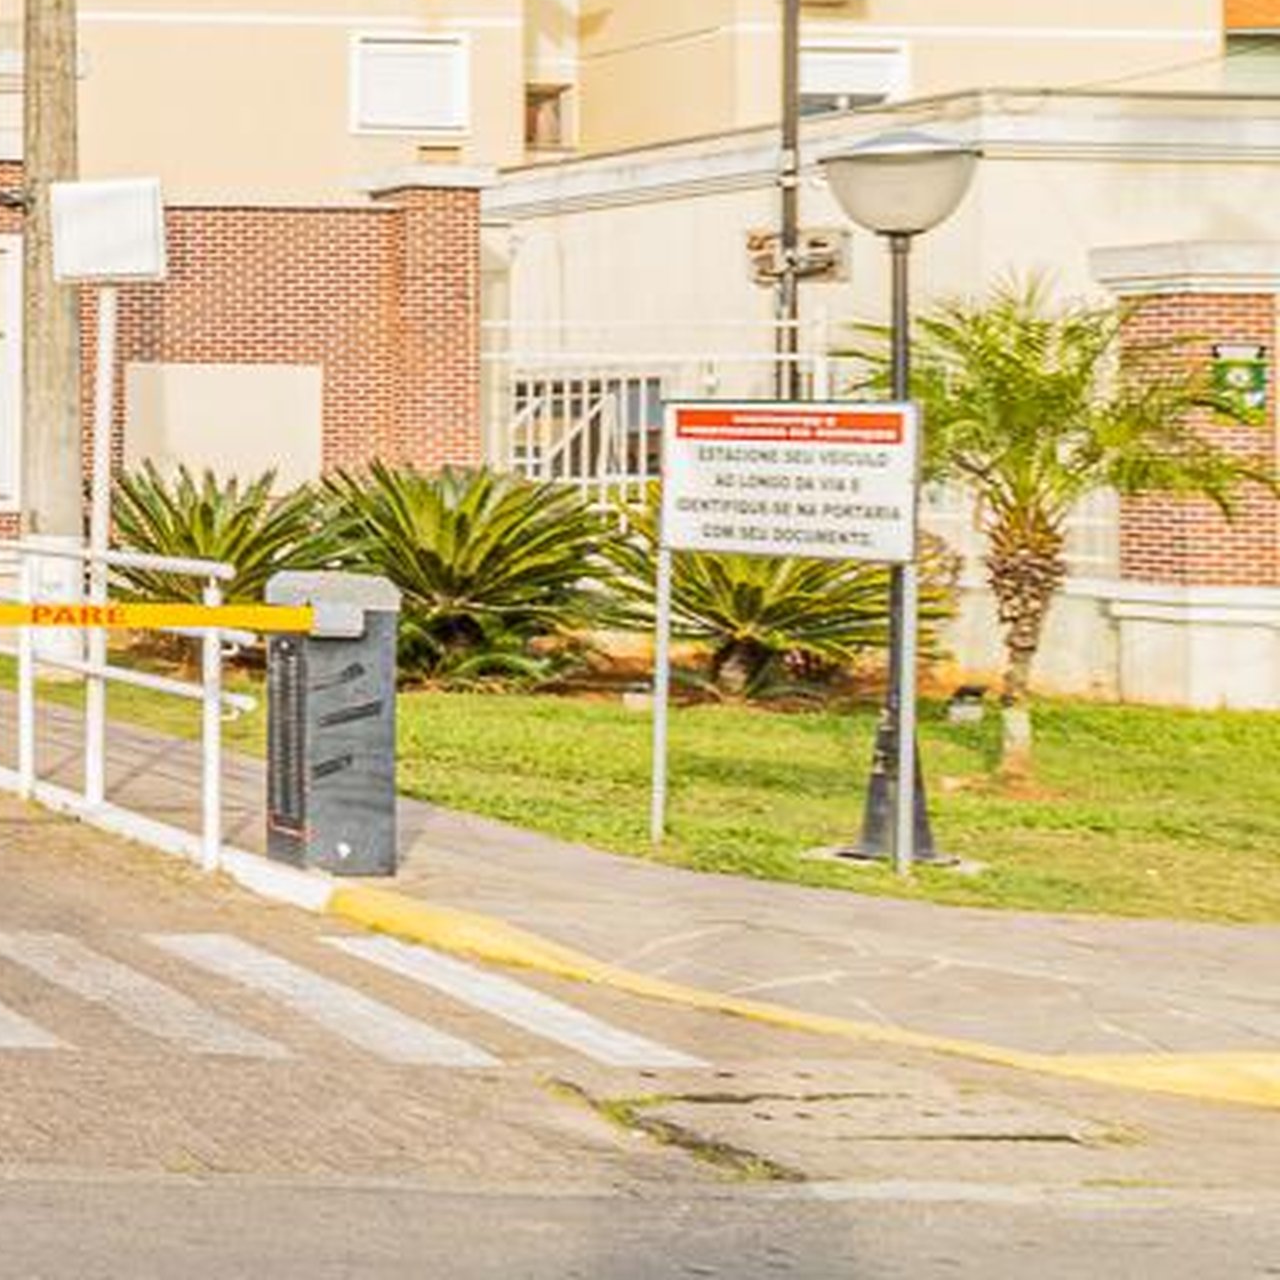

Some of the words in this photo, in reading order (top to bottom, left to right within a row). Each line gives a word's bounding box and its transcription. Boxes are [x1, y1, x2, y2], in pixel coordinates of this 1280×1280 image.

[698, 446, 778, 463] ESTACIONE
[784, 448, 814, 464] SEU
[715, 473, 736, 488] AO
[740, 474, 790, 489] LONGO
[795, 476, 814, 491] DA
[821, 477, 846, 492] VIA
[850, 479, 860, 494] E
[797, 500, 817, 516] NA
[822, 501, 901, 520] PORTARIA
[702, 523, 735, 538] COM
[739, 525, 768, 541] SEU
[31, 606, 127, 626] PARE
